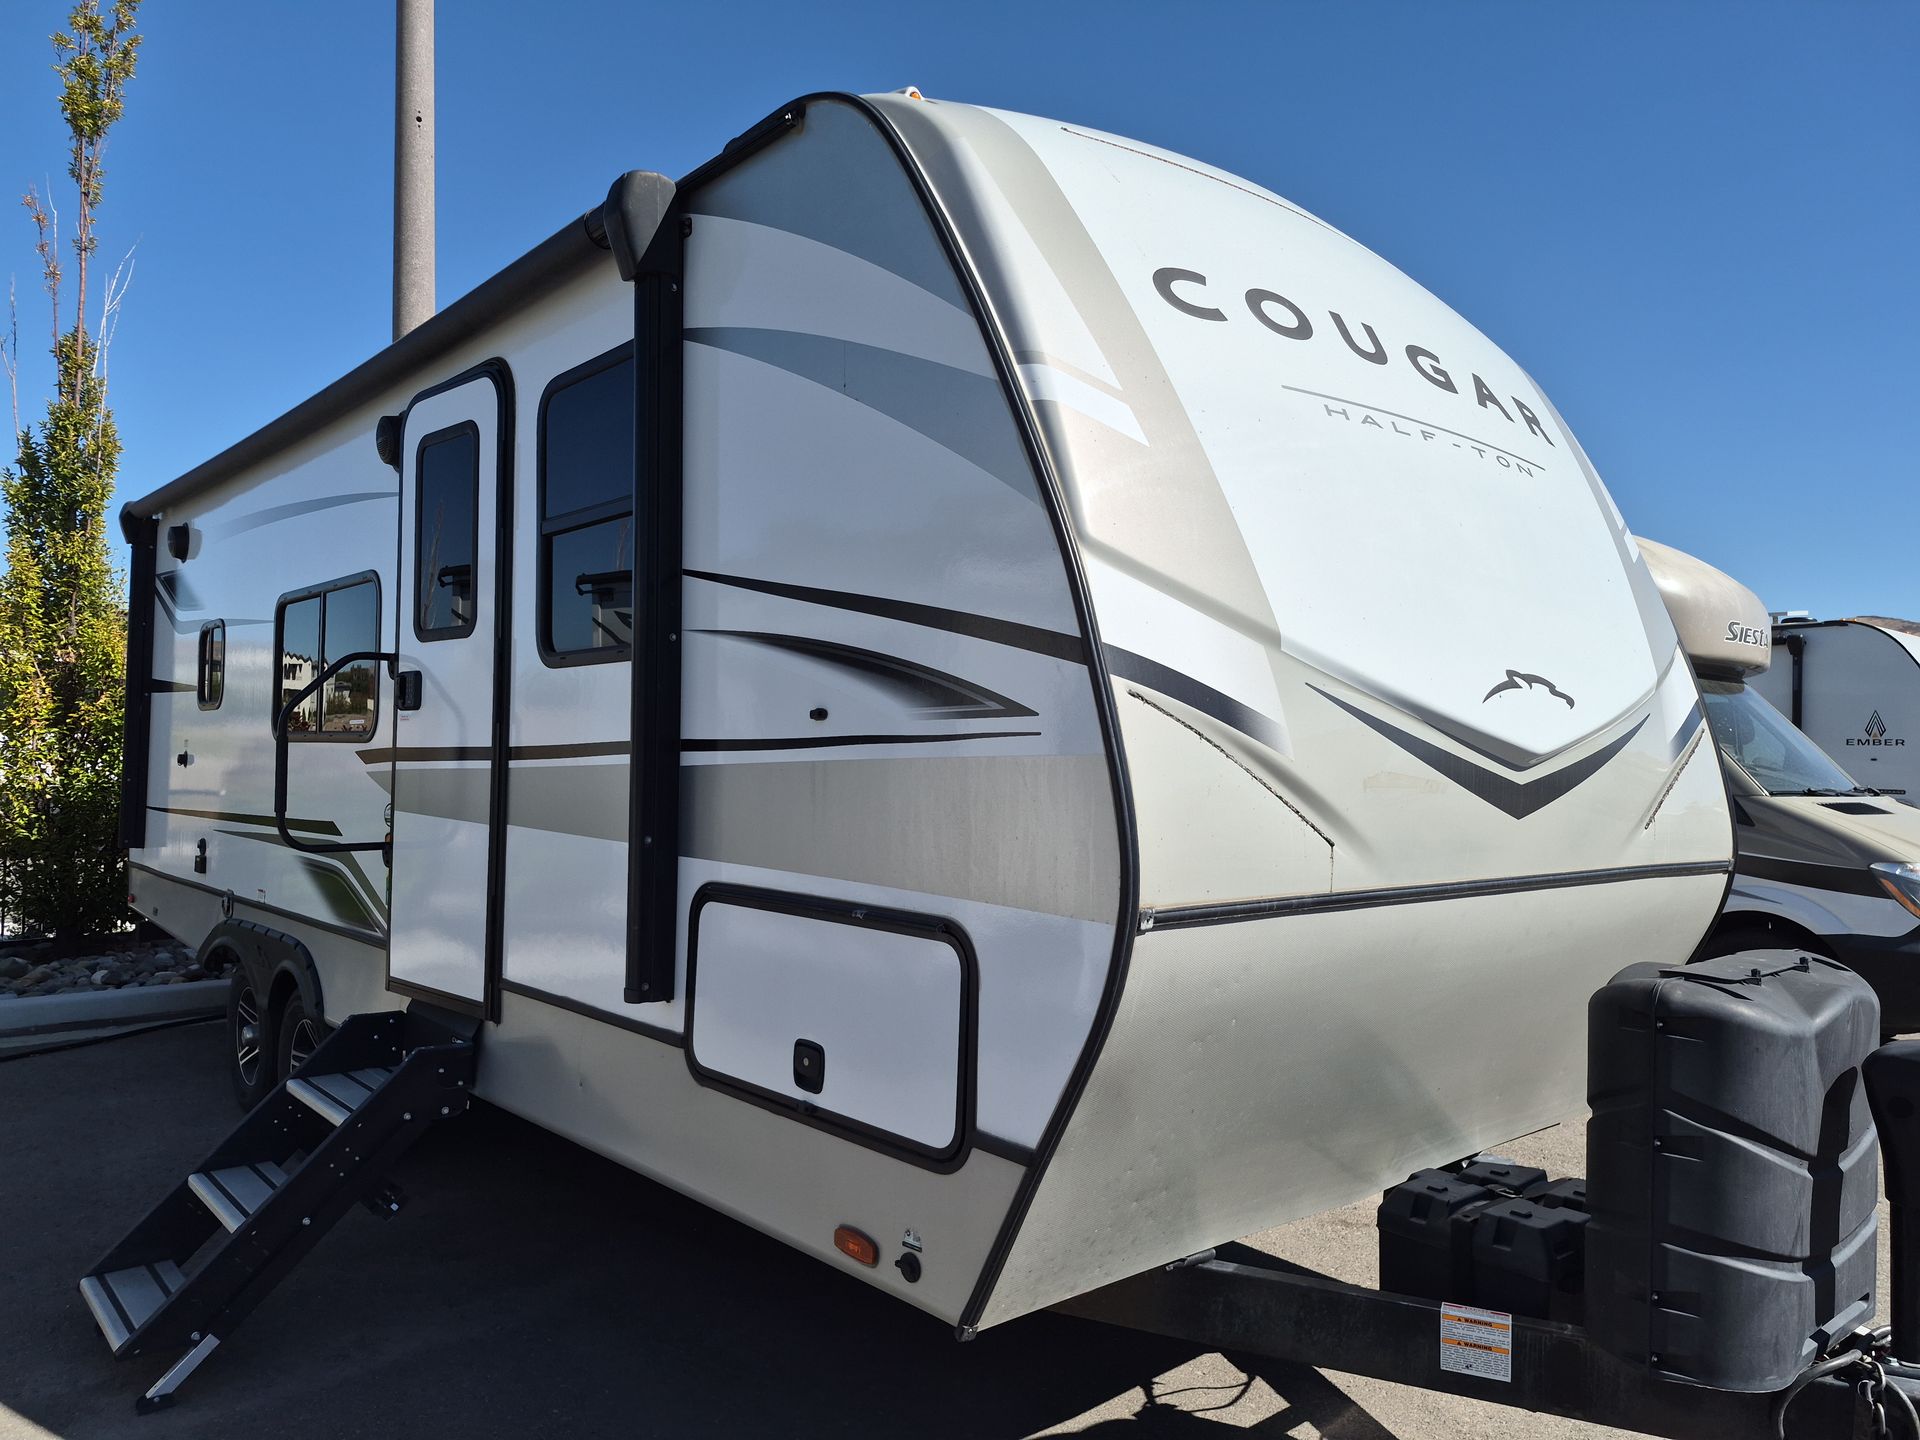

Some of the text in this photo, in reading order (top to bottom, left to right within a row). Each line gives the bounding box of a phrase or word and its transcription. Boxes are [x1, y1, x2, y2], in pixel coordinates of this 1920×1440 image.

[1152, 267, 1556, 448] COUGAR
[1323, 403, 1534, 478] HALF-TON
[1846, 738, 1905, 747] EMBER
[1464, 1317, 1492, 1327] WARNING
[1464, 1341, 1492, 1351] WARNING
